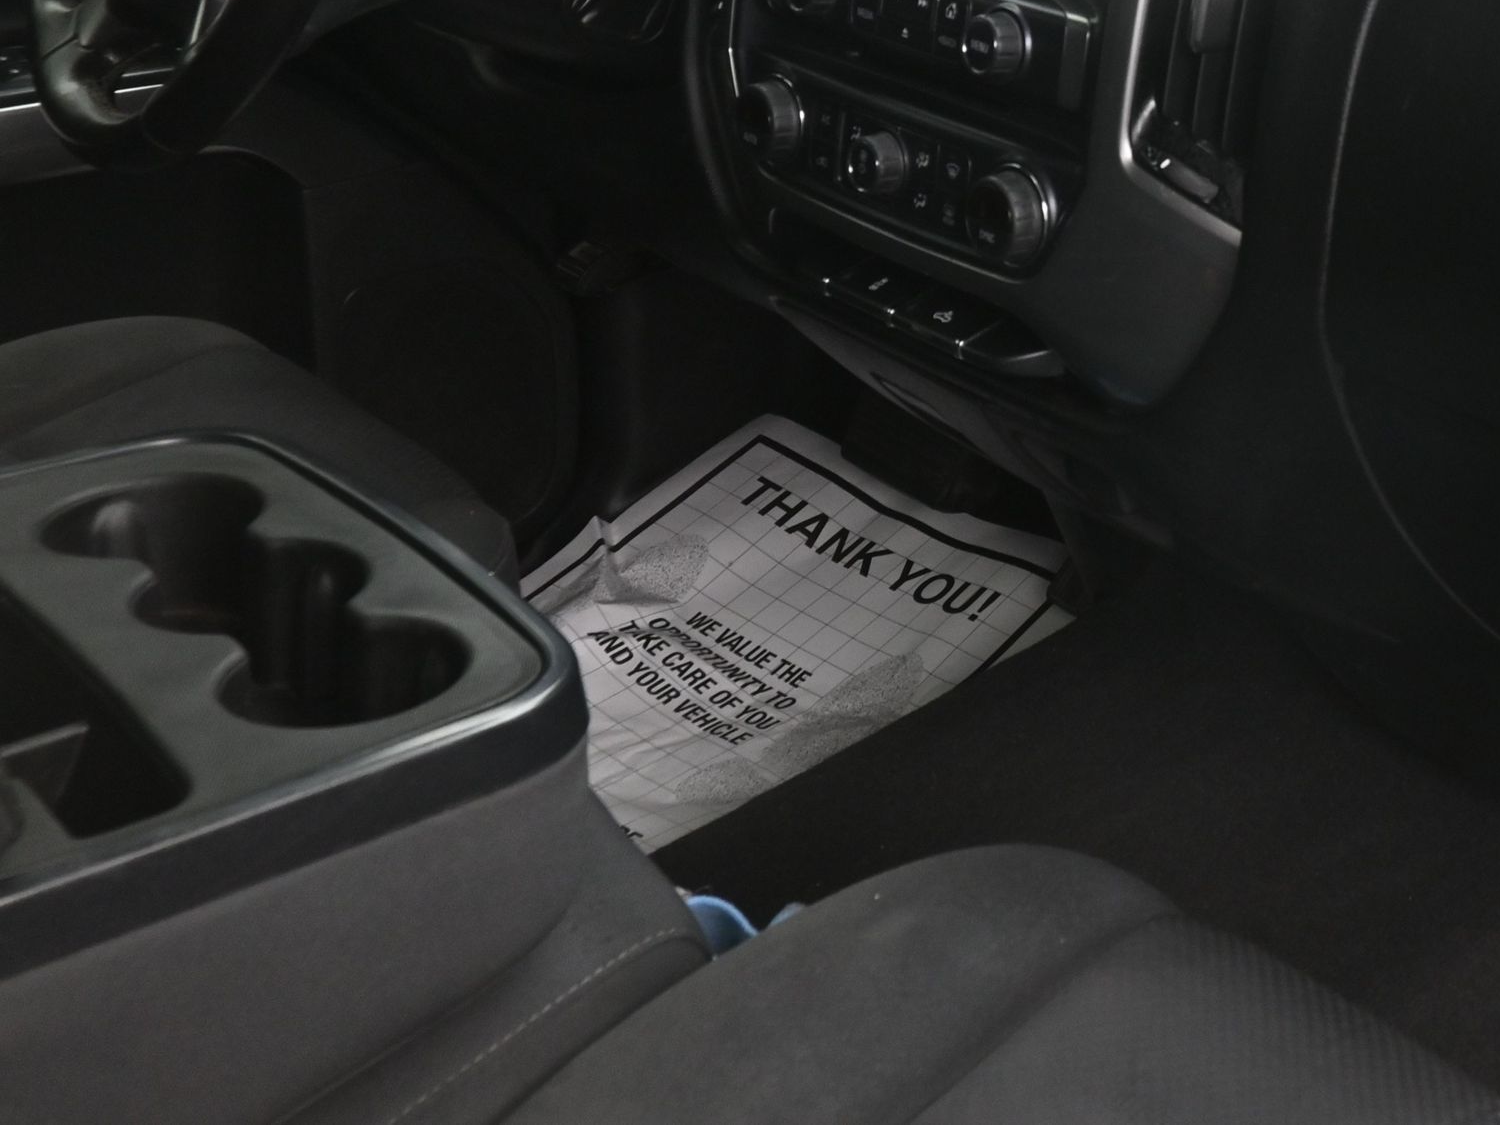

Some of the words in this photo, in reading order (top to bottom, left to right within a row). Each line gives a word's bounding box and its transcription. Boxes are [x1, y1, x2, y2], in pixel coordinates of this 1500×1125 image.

[741, 476, 895, 578] THANK
[889, 558, 1001, 623] YOU!
[587, 630, 634, 665] AND
[627, 661, 681, 705] YOUR
[673, 698, 754, 746] VEHICLE
[618, 619, 671, 657] TAKE
[661, 651, 718, 695] CARE
[709, 689, 744, 709] OF
[735, 704, 781, 731] YOU
[648, 617, 773, 697] OPPORTUNITY
[765, 690, 798, 710] TO
[686, 611, 722, 637] WE
[715, 628, 777, 670] VALUE
[770, 658, 812, 689] THE
